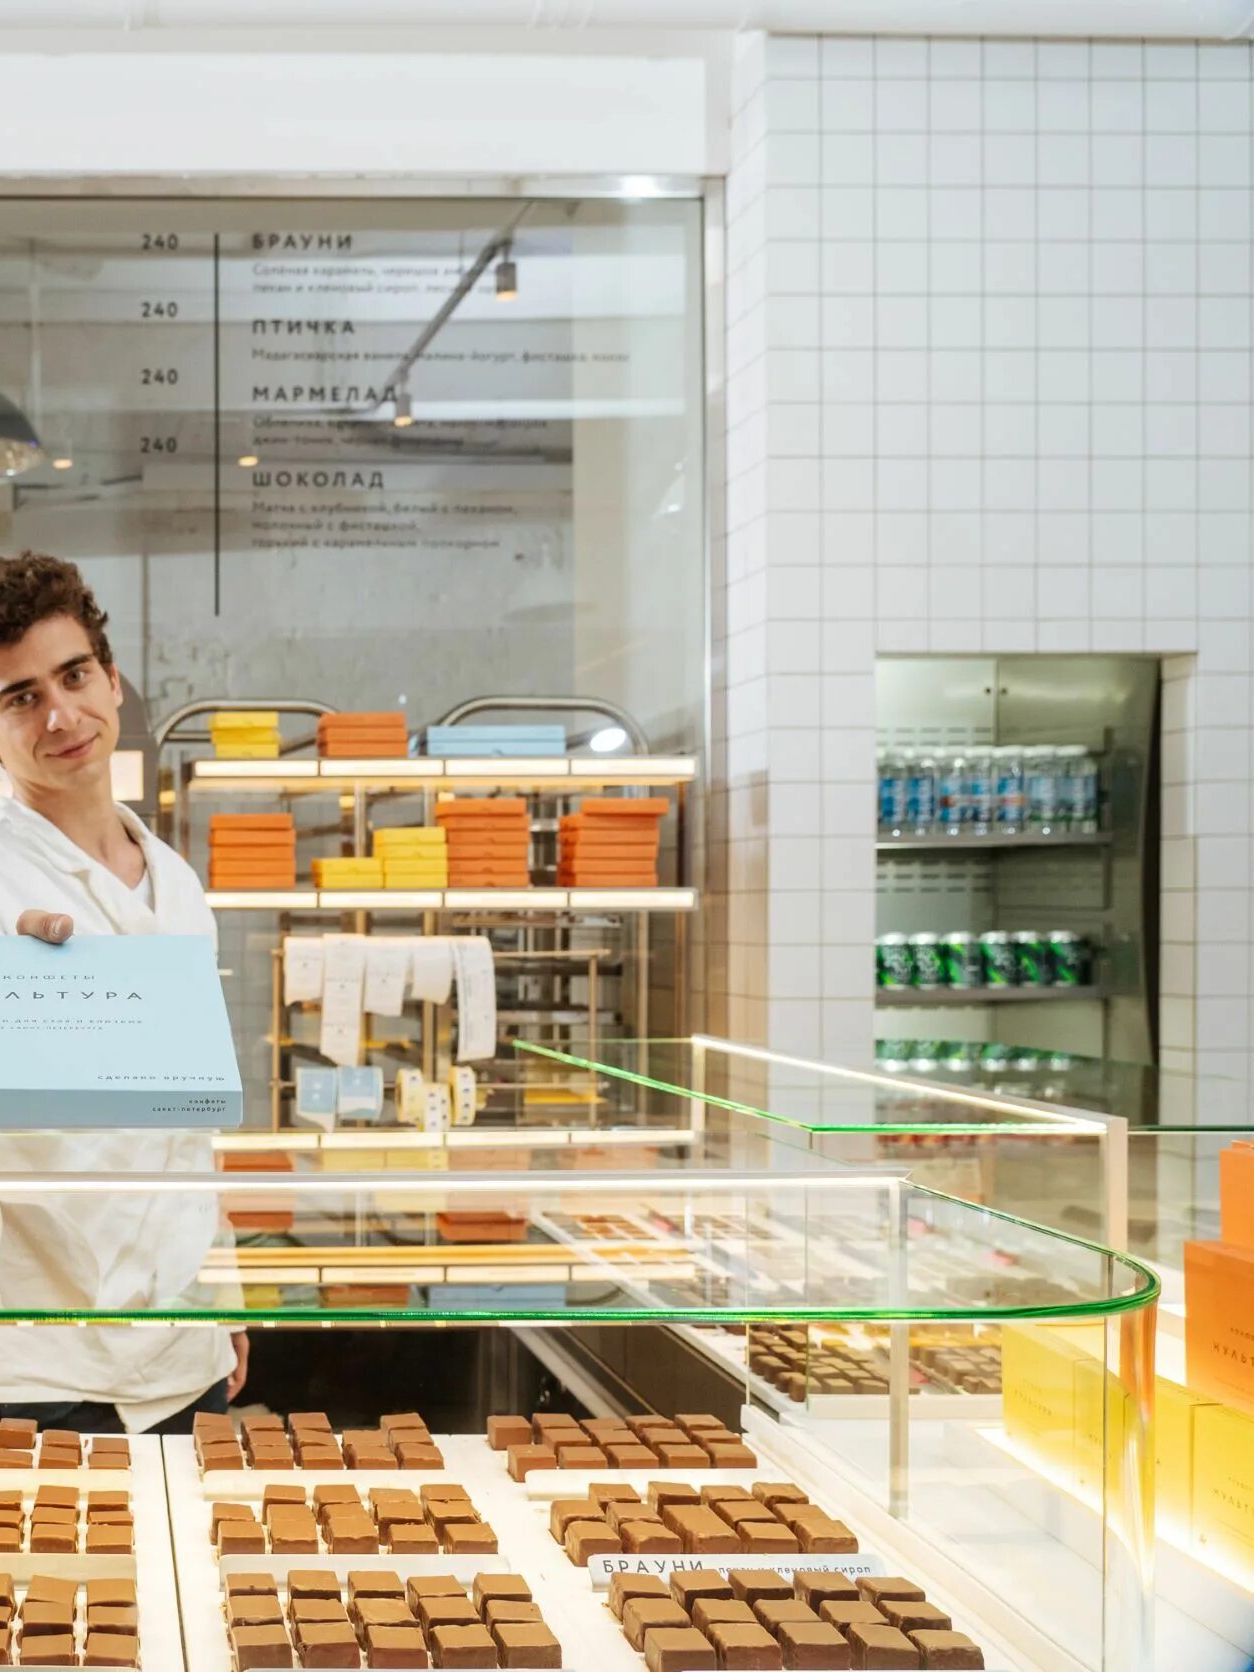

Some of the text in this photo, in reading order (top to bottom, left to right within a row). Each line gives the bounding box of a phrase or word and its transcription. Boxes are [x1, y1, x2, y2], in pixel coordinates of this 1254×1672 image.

[141, 234, 179, 250] 240
[252, 234, 353, 250] БРАУНИ
[141, 302, 179, 318] 240
[252, 320, 355, 335] ПТИЧКА
[141, 369, 179, 385] 240
[253, 386, 398, 402] МАРМЕЛАД
[140, 438, 178, 453] 240
[252, 472, 384, 490] ШОКОЛАД
[602, 1560, 703, 1573] БРАУНИ
[834, 1566, 871, 1575] сироп
